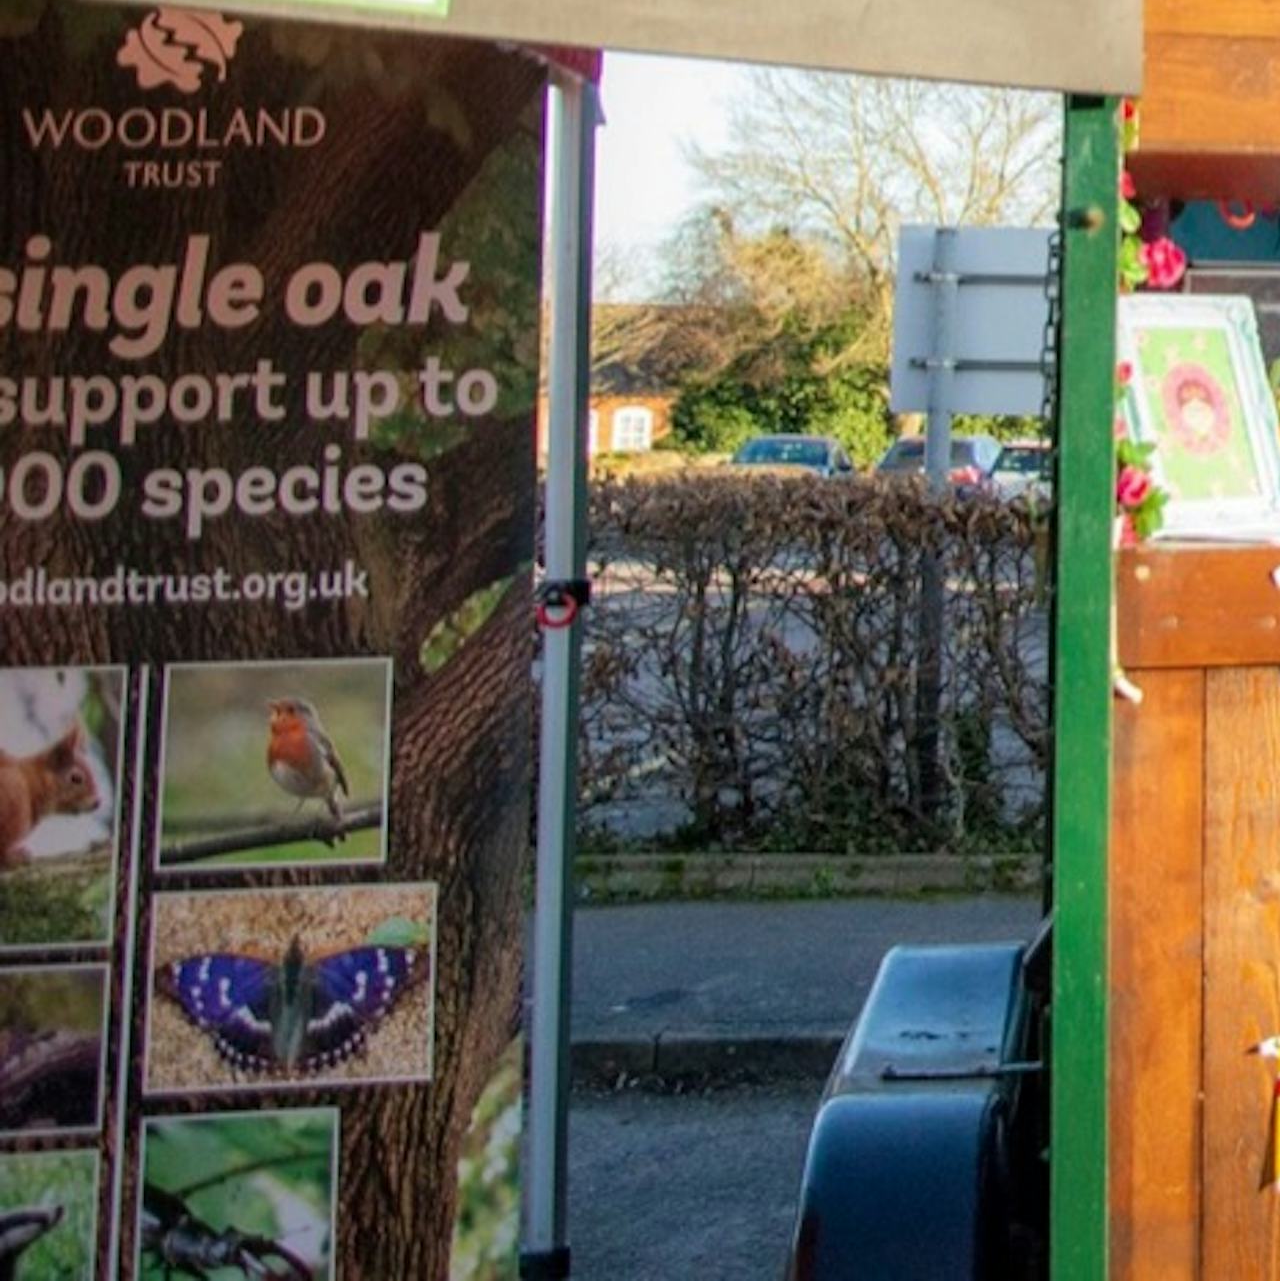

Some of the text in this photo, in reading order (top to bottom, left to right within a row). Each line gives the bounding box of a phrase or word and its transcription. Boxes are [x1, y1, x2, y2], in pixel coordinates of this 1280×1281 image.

[22, 106, 326, 150] WOODLAND
[123, 159, 222, 189] TRUST
[284, 231, 471, 327] oak
[306, 368, 400, 440] up
[418, 356, 499, 420] to
[0, 444, 429, 540] 00 species
[0, 560, 369, 612] dlandtrust.org.uk
